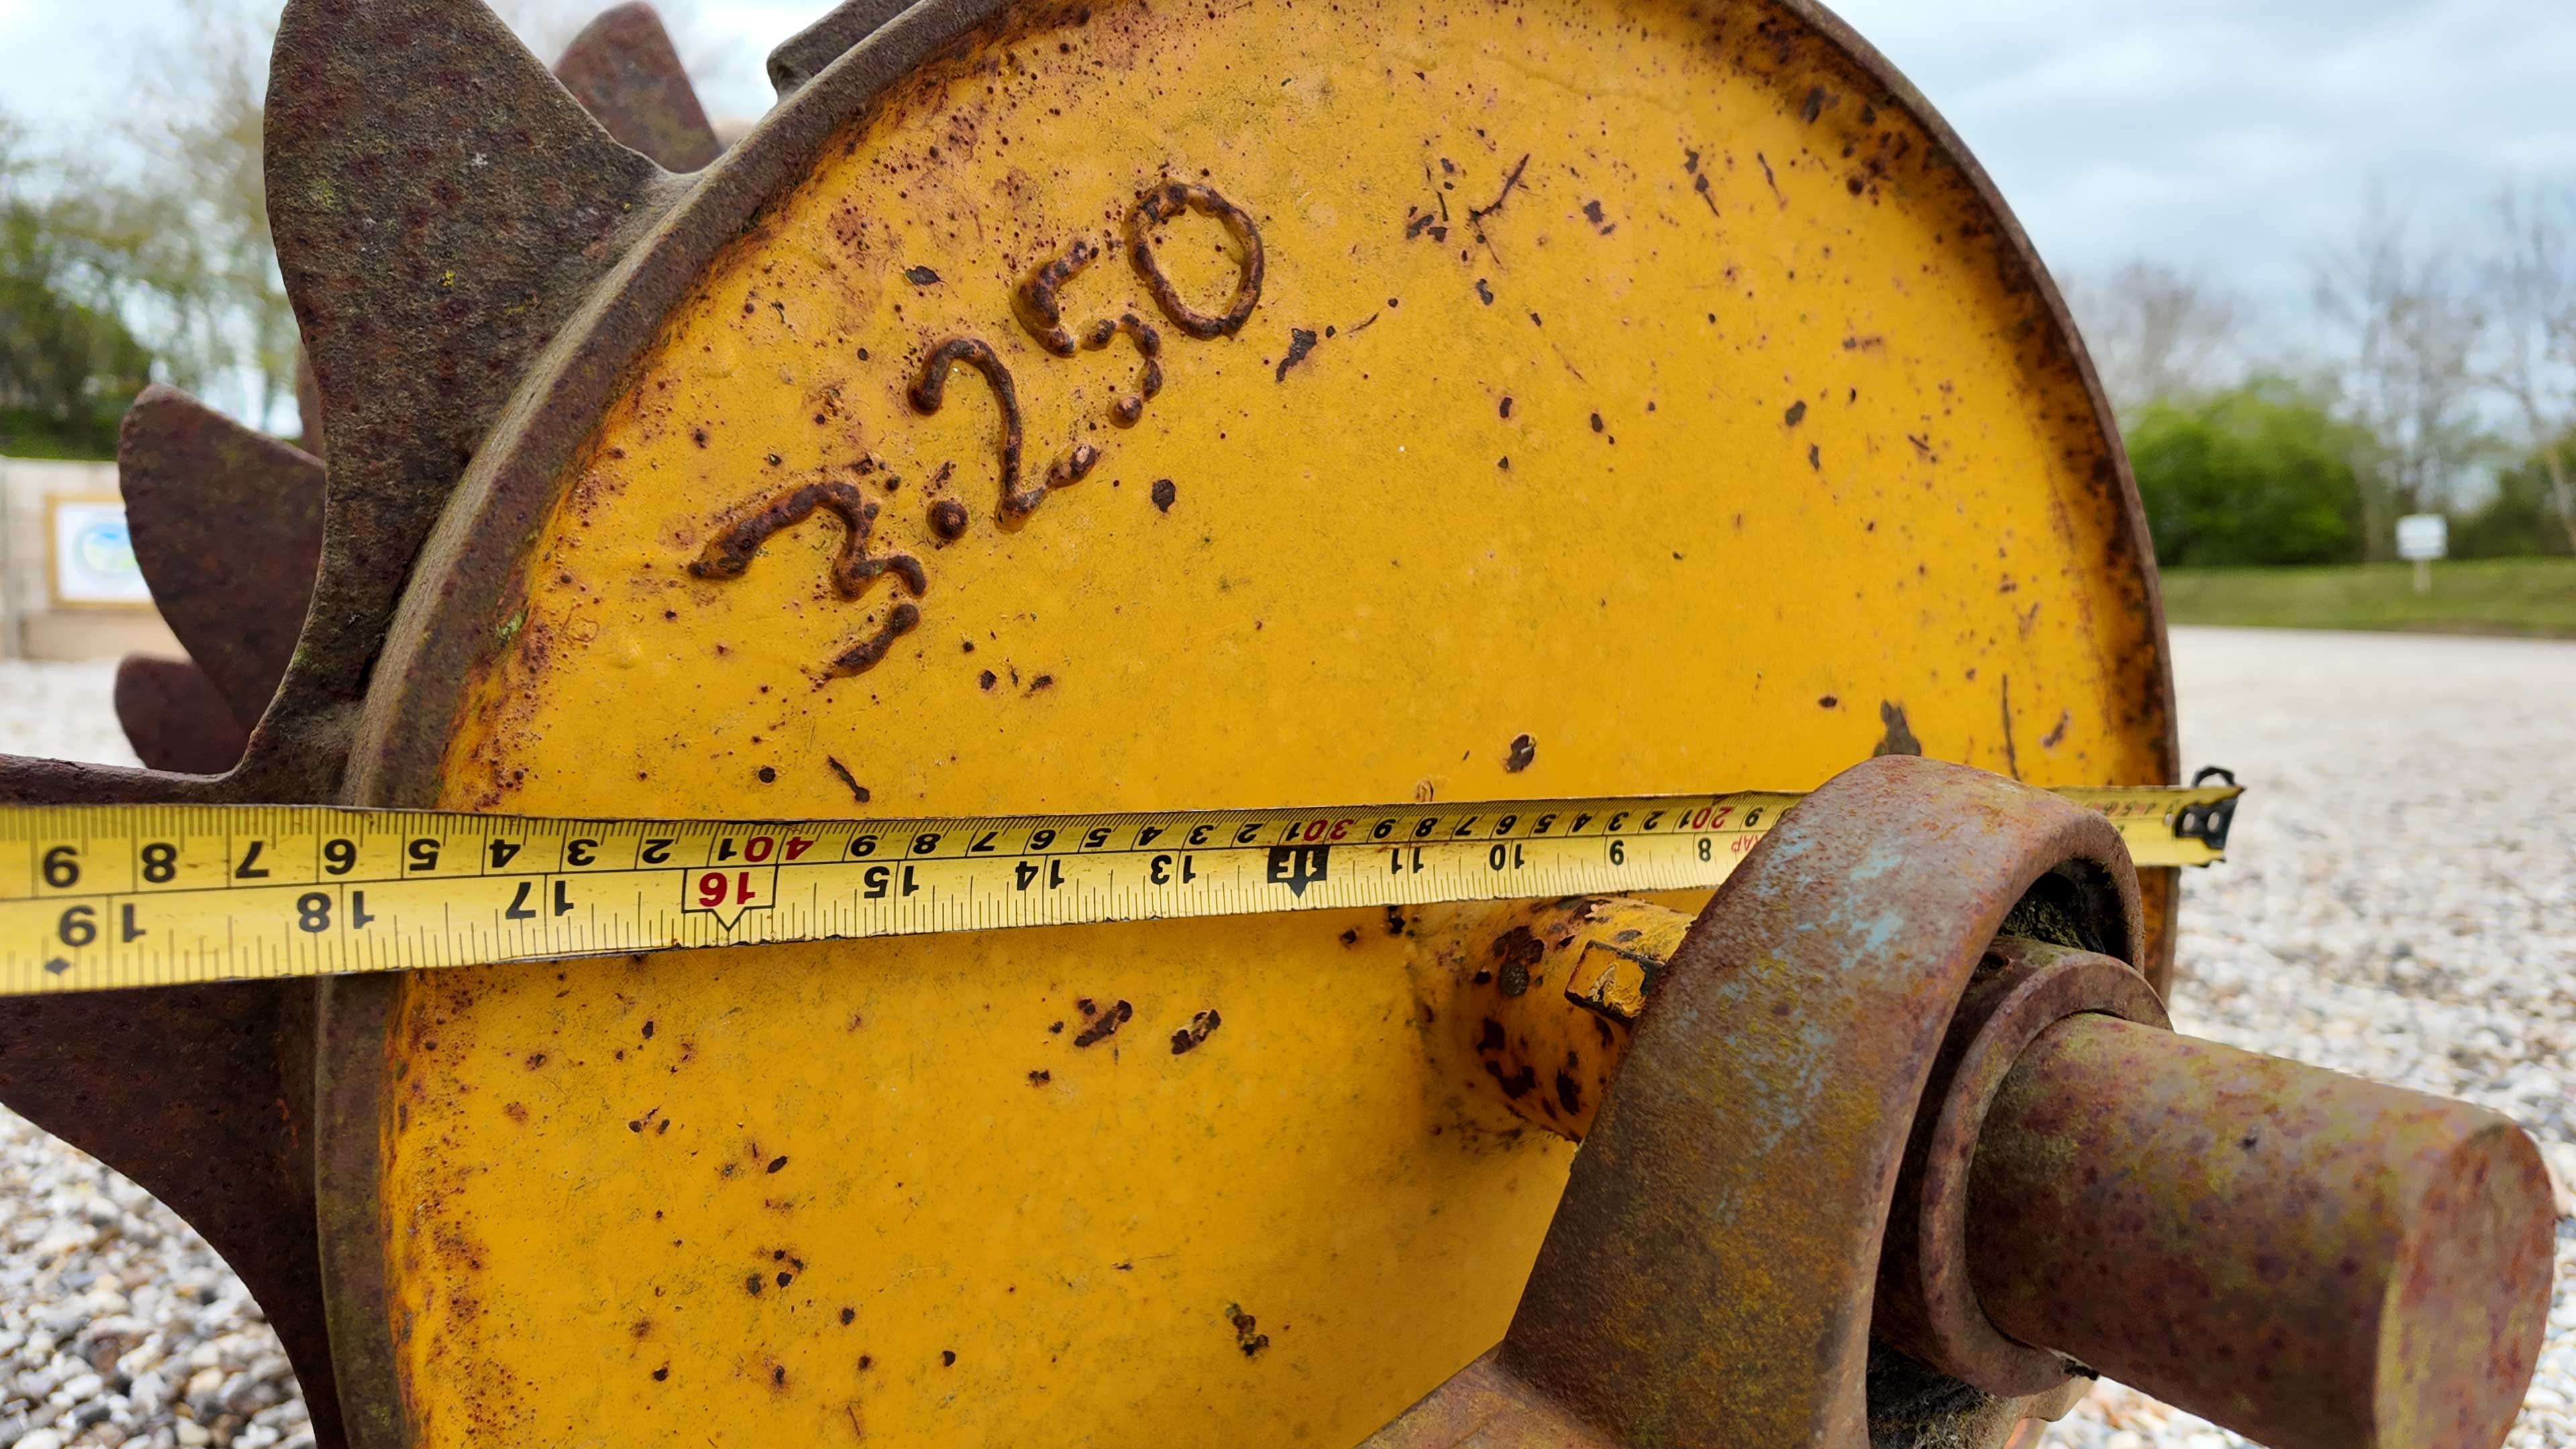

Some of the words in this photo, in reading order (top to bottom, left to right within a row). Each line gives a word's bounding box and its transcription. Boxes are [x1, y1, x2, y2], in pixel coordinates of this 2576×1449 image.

[688, 181, 1265, 680] 3.250
[1373, 818, 1397, 839] 9
[1415, 816, 1438, 837] 8
[1456, 816, 1478, 837] 7
[1496, 814, 1517, 835] 6
[1534, 814, 1556, 834] 5
[1572, 813, 1593, 833] 4
[1609, 812, 1629, 831] 3
[1644, 810, 1667, 830] 2
[1692, 806, 1732, 828] 20
[1745, 807, 1763, 826] 9
[971, 831, 998, 852] 7
[1030, 829, 1057, 850] 6
[1084, 828, 1112, 849] 5
[1138, 826, 1164, 846] 4
[1189, 824, 1215, 845] 3
[1236, 822, 1263, 843] 2
[1303, 818, 1354, 841] 30
[409, 839, 441, 871] 5
[489, 839, 521, 868] 4
[568, 839, 598, 867] 3
[642, 839, 674, 864] 2
[744, 836, 814, 863] 40
[851, 835, 878, 857] 9
[913, 833, 942, 854] 8
[1609, 839, 1624, 866] 9
[1698, 837, 1711, 862] 8
[42, 845, 80, 888] 9
[141, 842, 177, 883] 8
[235, 841, 269, 879] 7
[325, 839, 357, 875] 6
[1390, 848, 1424, 875] 11
[1489, 843, 1525, 871] 10
[863, 865, 920, 900] 15
[1014, 859, 1065, 892] 14
[1150, 854, 1197, 886] 13
[505, 880, 574, 920] 17
[698, 871, 756, 908] 16
[297, 890, 375, 932] 18
[58, 903, 147, 948] 19
